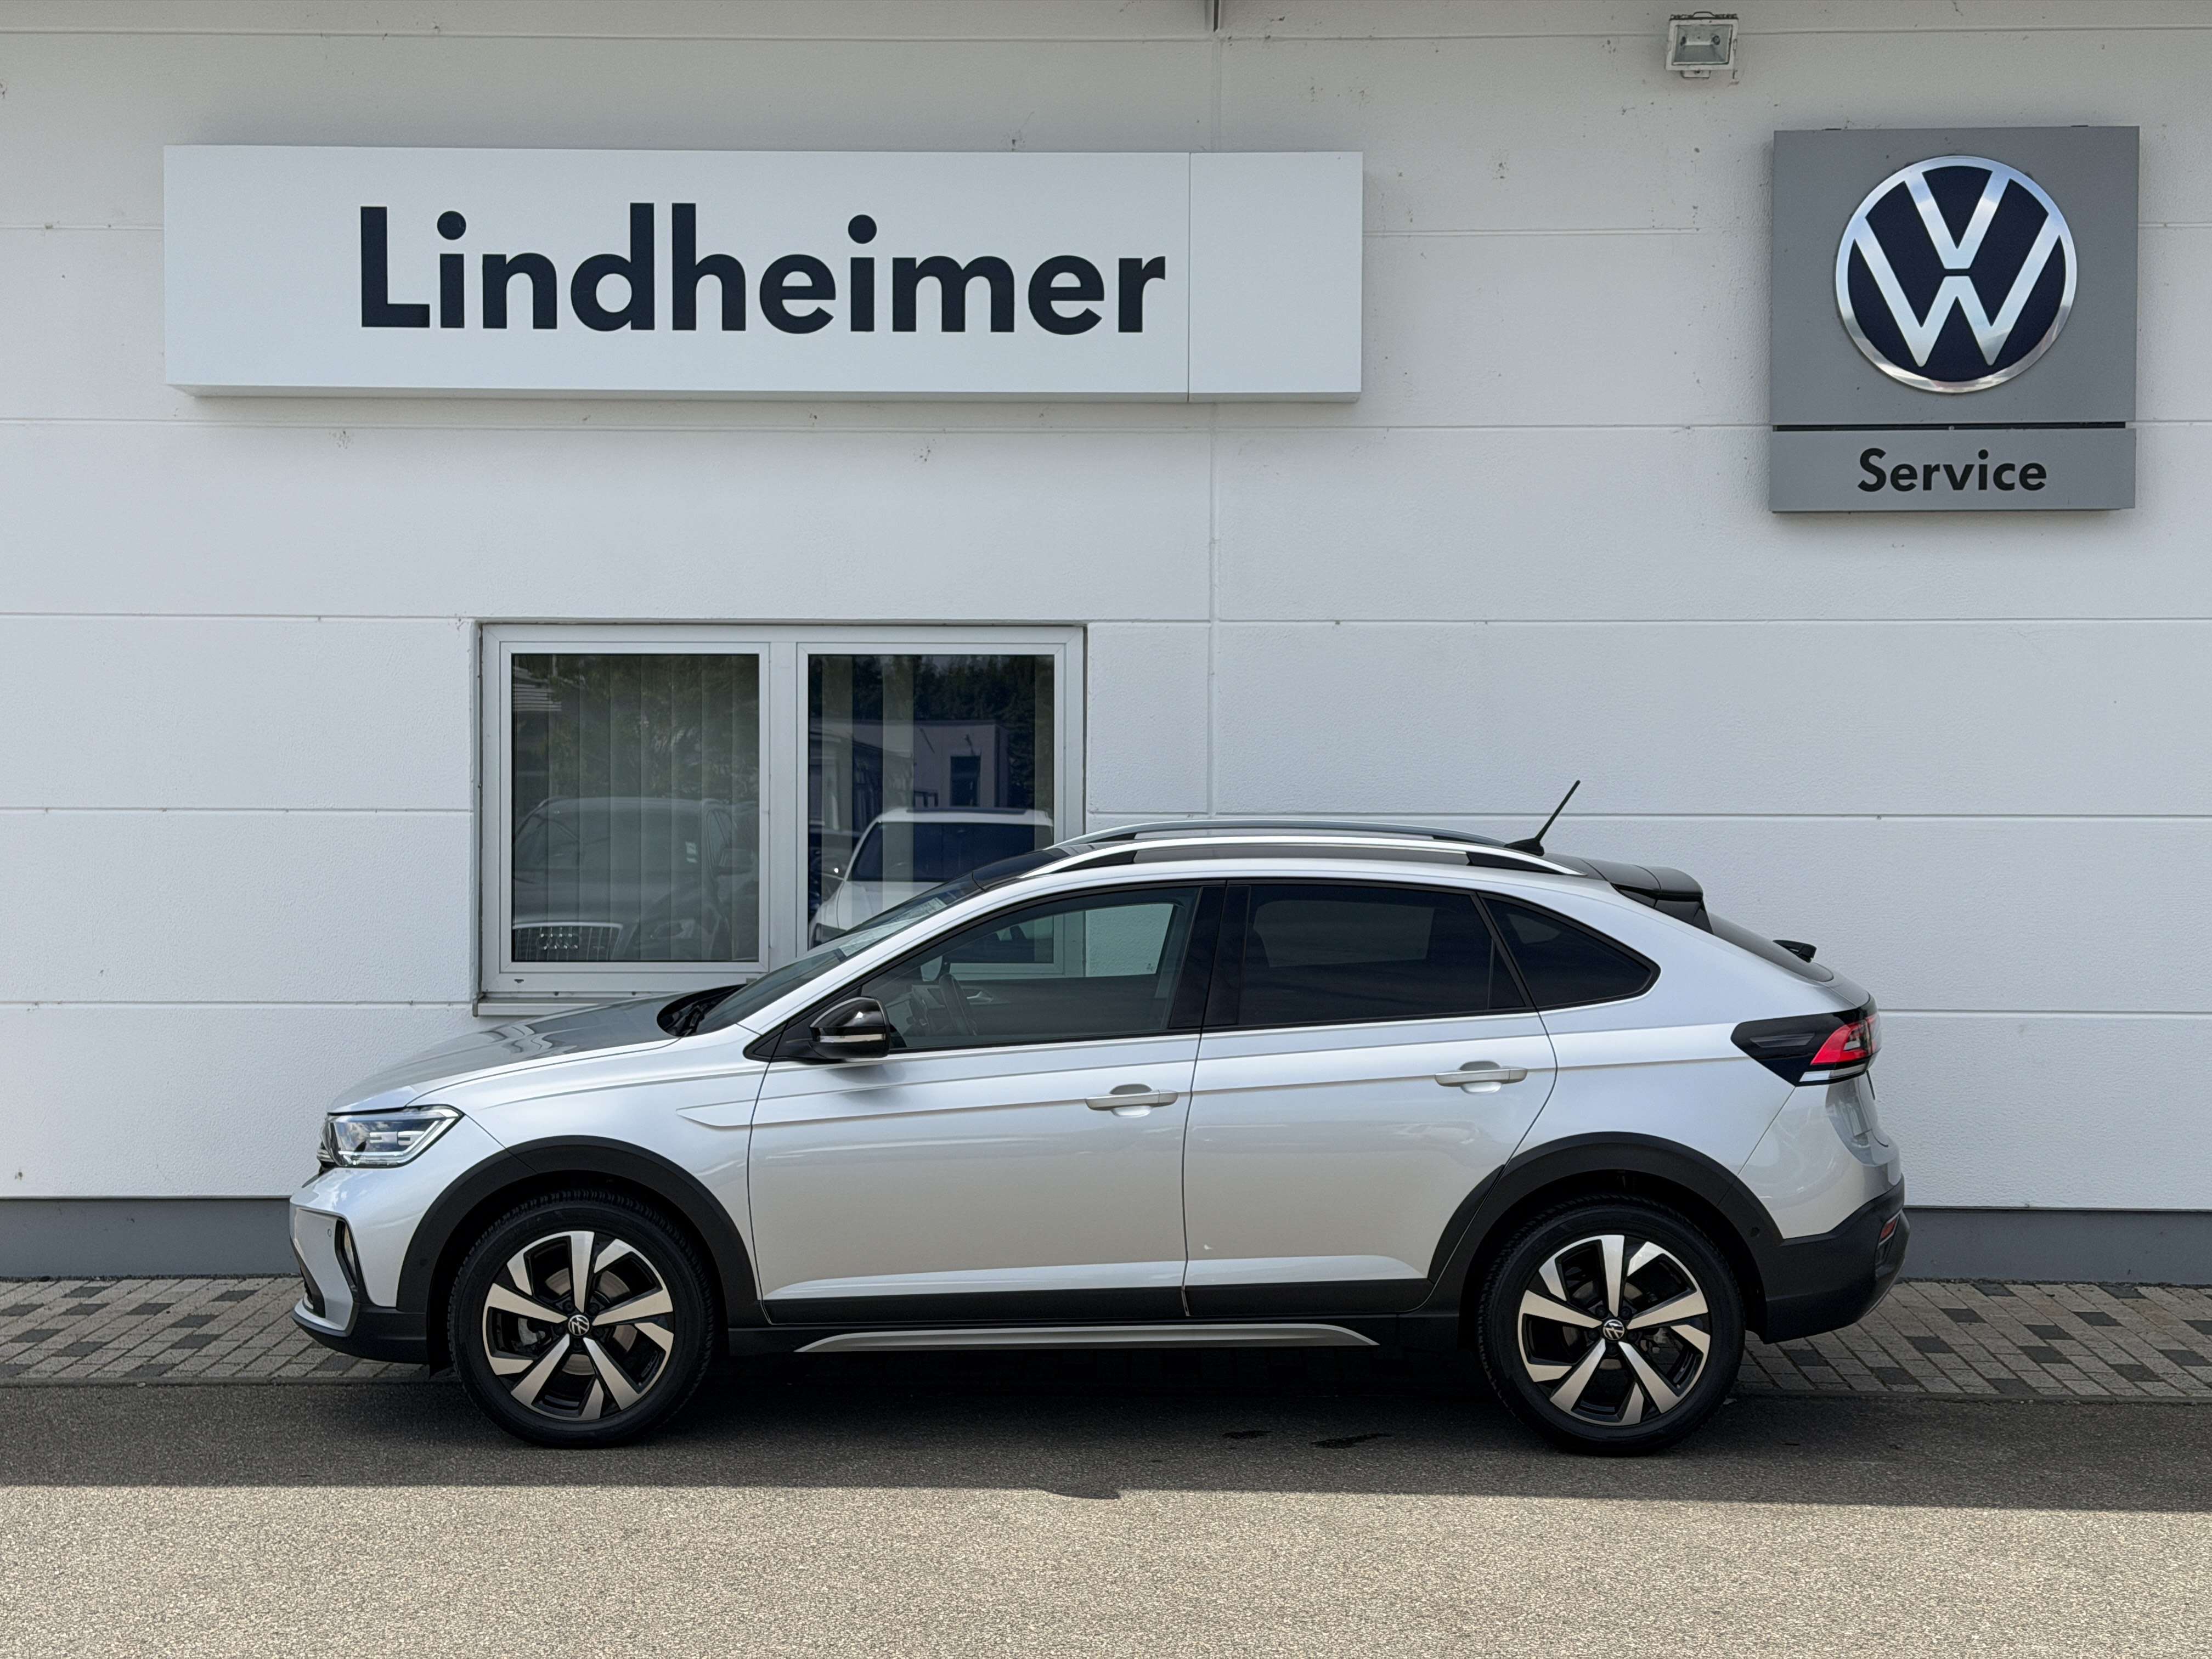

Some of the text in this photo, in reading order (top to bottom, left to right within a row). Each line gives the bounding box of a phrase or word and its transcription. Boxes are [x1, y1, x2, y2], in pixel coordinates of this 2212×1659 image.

[360, 202, 1166, 335] Lindheimer
[1841, 161, 2073, 379] VW
[1857, 448, 2047, 492] Service
